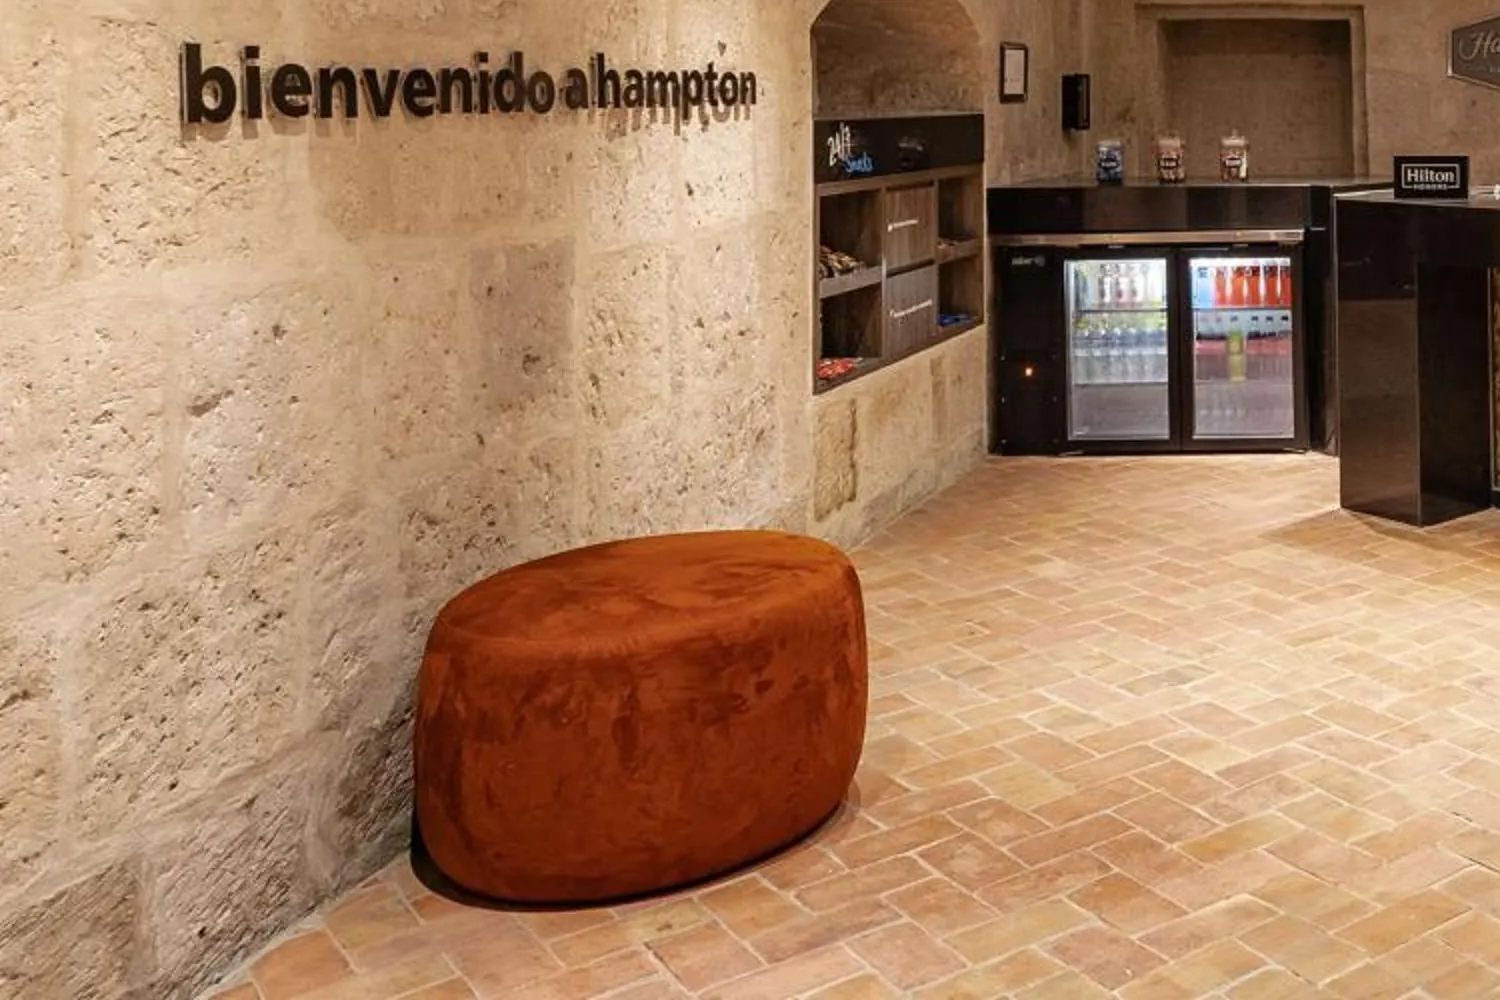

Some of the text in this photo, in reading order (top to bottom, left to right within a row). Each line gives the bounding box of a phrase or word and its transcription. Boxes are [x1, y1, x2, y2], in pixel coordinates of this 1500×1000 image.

[181, 42, 757, 124] bienvenido a hampton
[1407, 168, 1455, 183] Hilton
